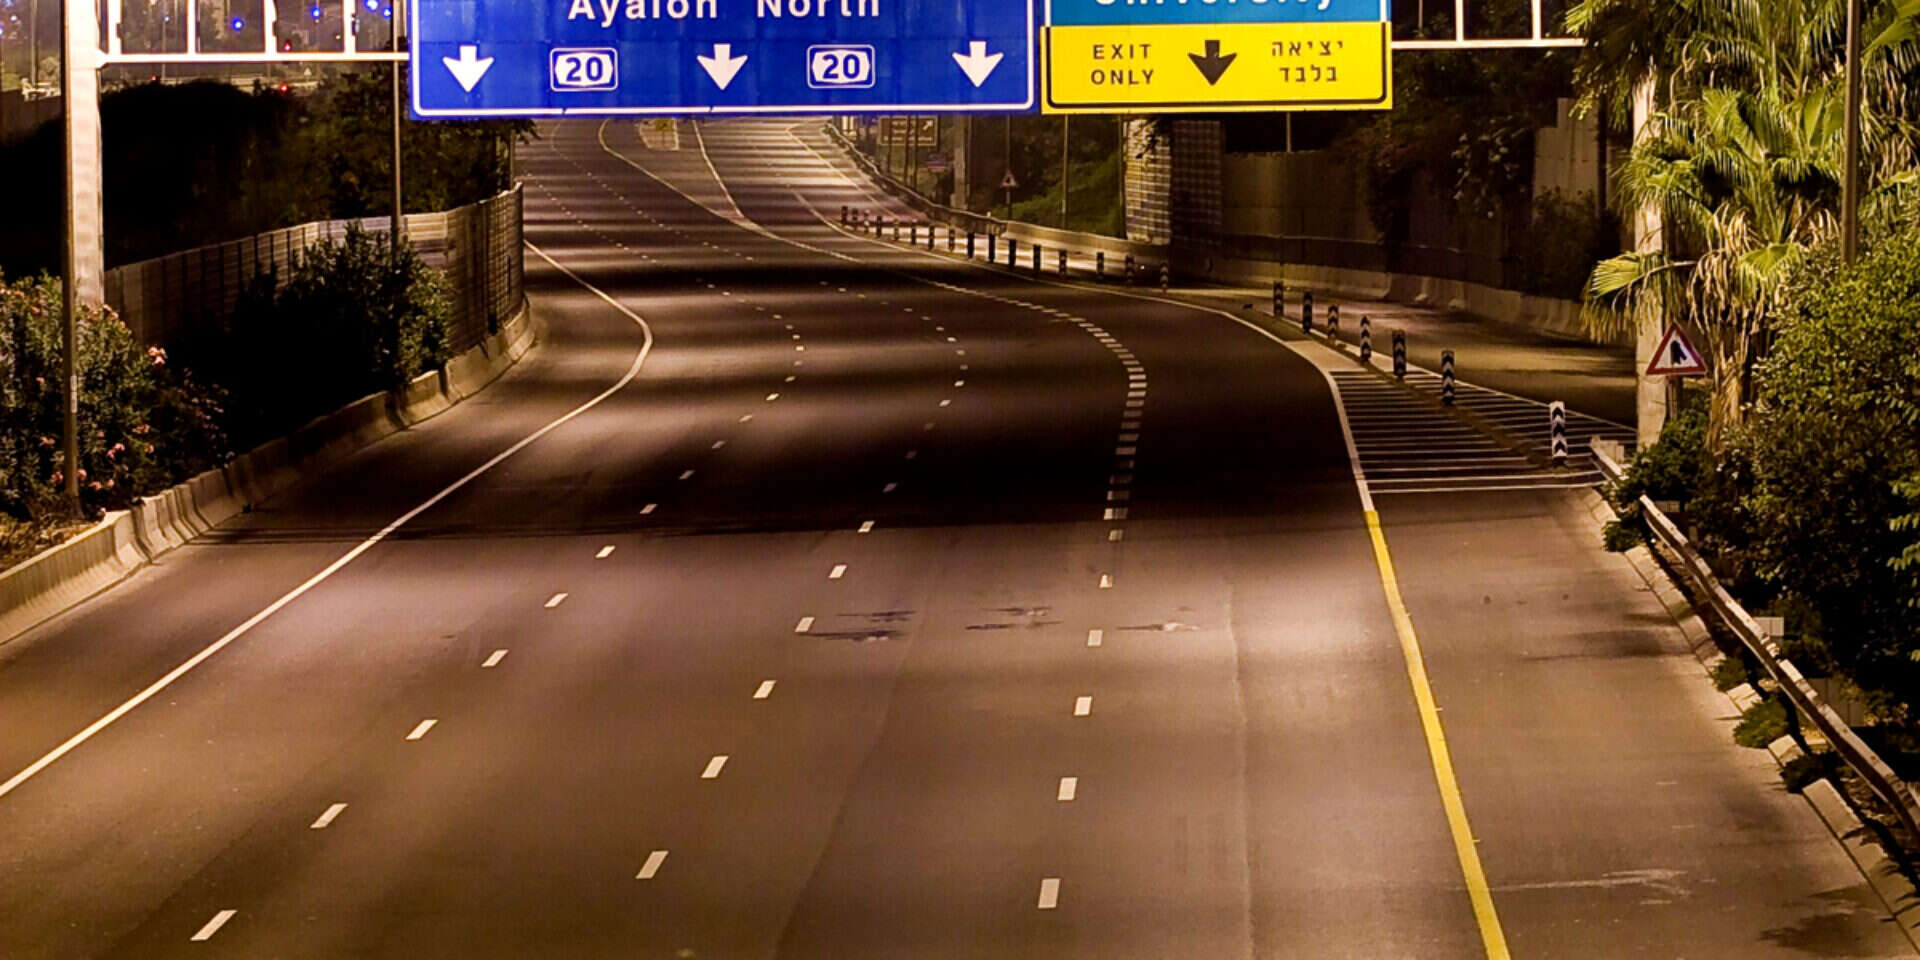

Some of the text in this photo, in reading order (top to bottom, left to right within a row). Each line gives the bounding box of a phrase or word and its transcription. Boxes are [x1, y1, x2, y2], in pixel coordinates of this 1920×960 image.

[567, 0, 880, 28] Ayalon North
[1092, 44, 1152, 60] EXIT
[1271, 41, 1344, 57] יציאה
[565, 57, 604, 82] 20
[822, 54, 860, 80] 20
[1279, 65, 1338, 83] בלבד
[1090, 69, 1154, 85] ONLY
